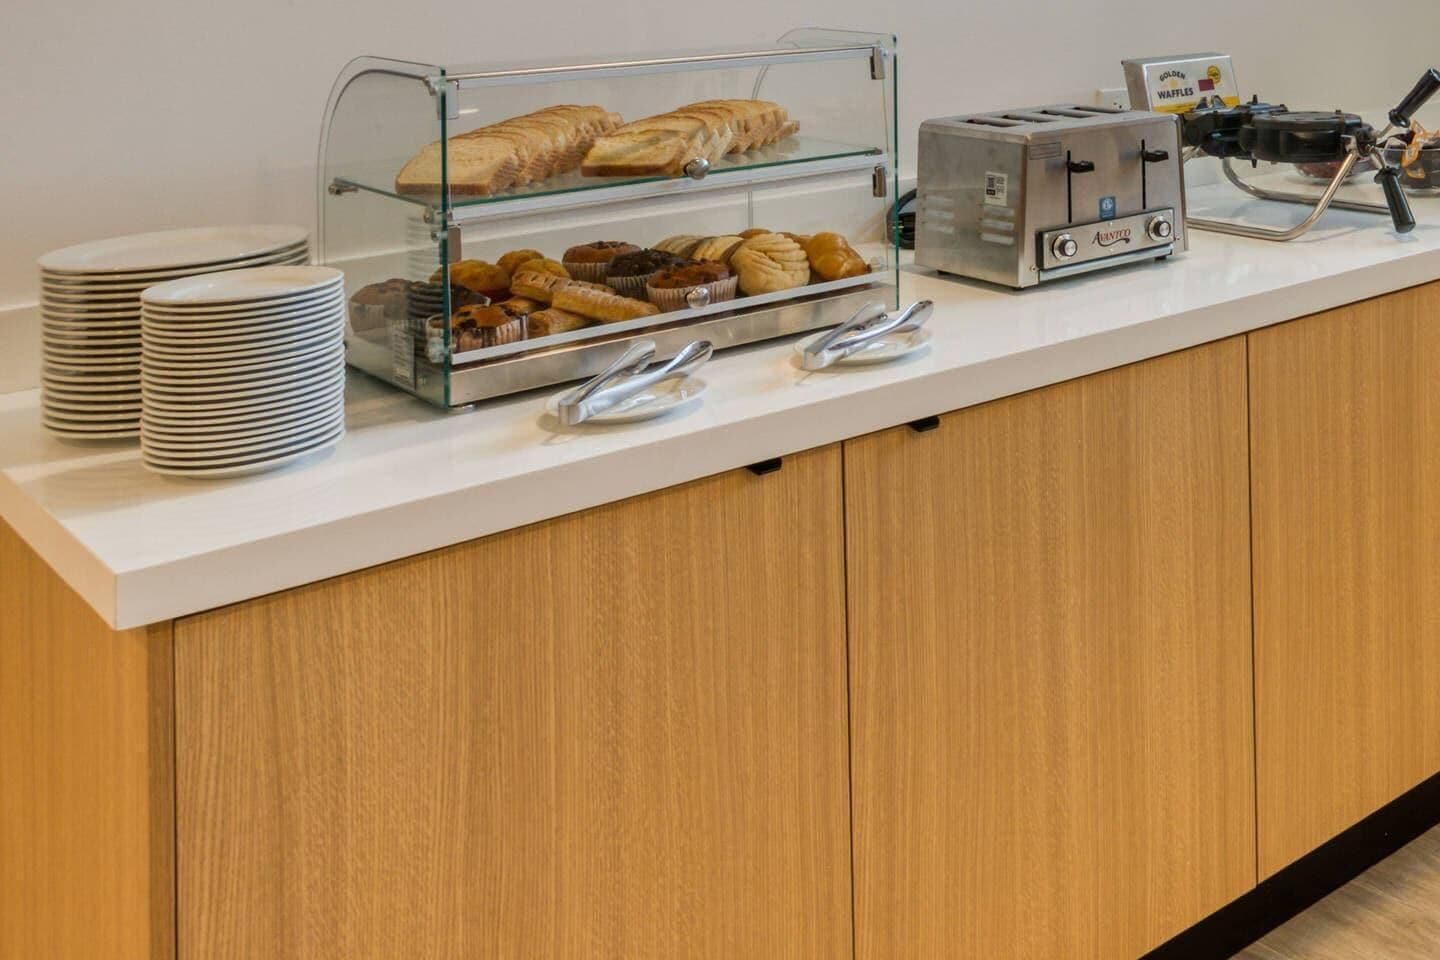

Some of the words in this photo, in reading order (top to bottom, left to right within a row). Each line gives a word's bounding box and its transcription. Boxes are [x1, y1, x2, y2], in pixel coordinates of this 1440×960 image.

[1159, 70, 1186, 82] GOLDEN
[1157, 87, 1194, 100] WAFFLES
[1092, 228, 1131, 247] AVANTCO
